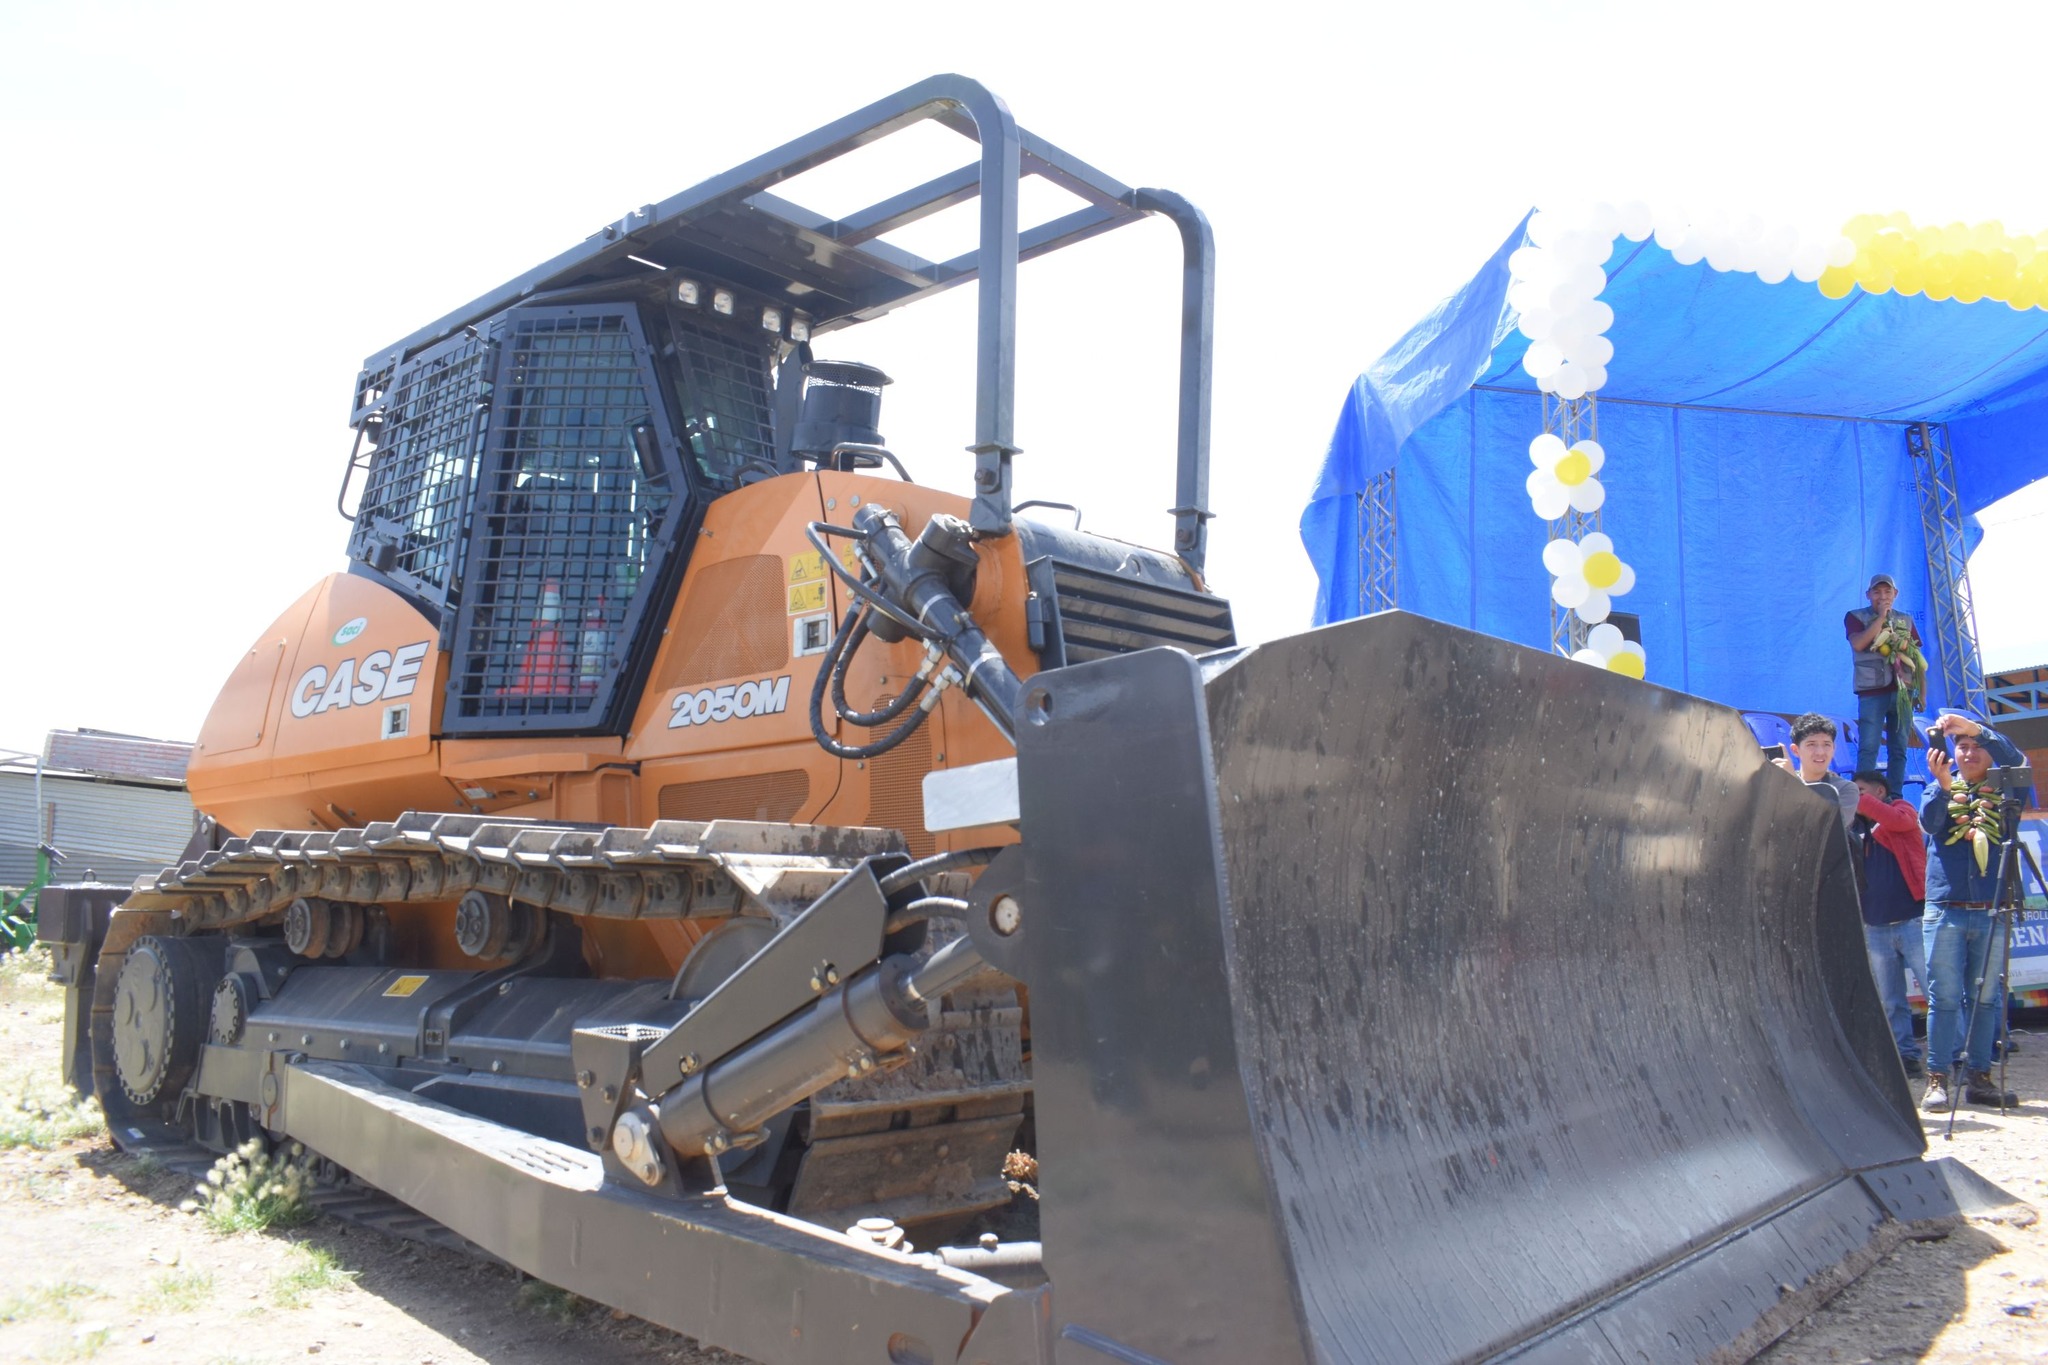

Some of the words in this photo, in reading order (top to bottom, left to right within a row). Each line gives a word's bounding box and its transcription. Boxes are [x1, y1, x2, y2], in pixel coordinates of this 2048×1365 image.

[341, 622, 363, 636] saci
[290, 640, 430, 719] CASE
[667, 675, 792, 729] 2050M
